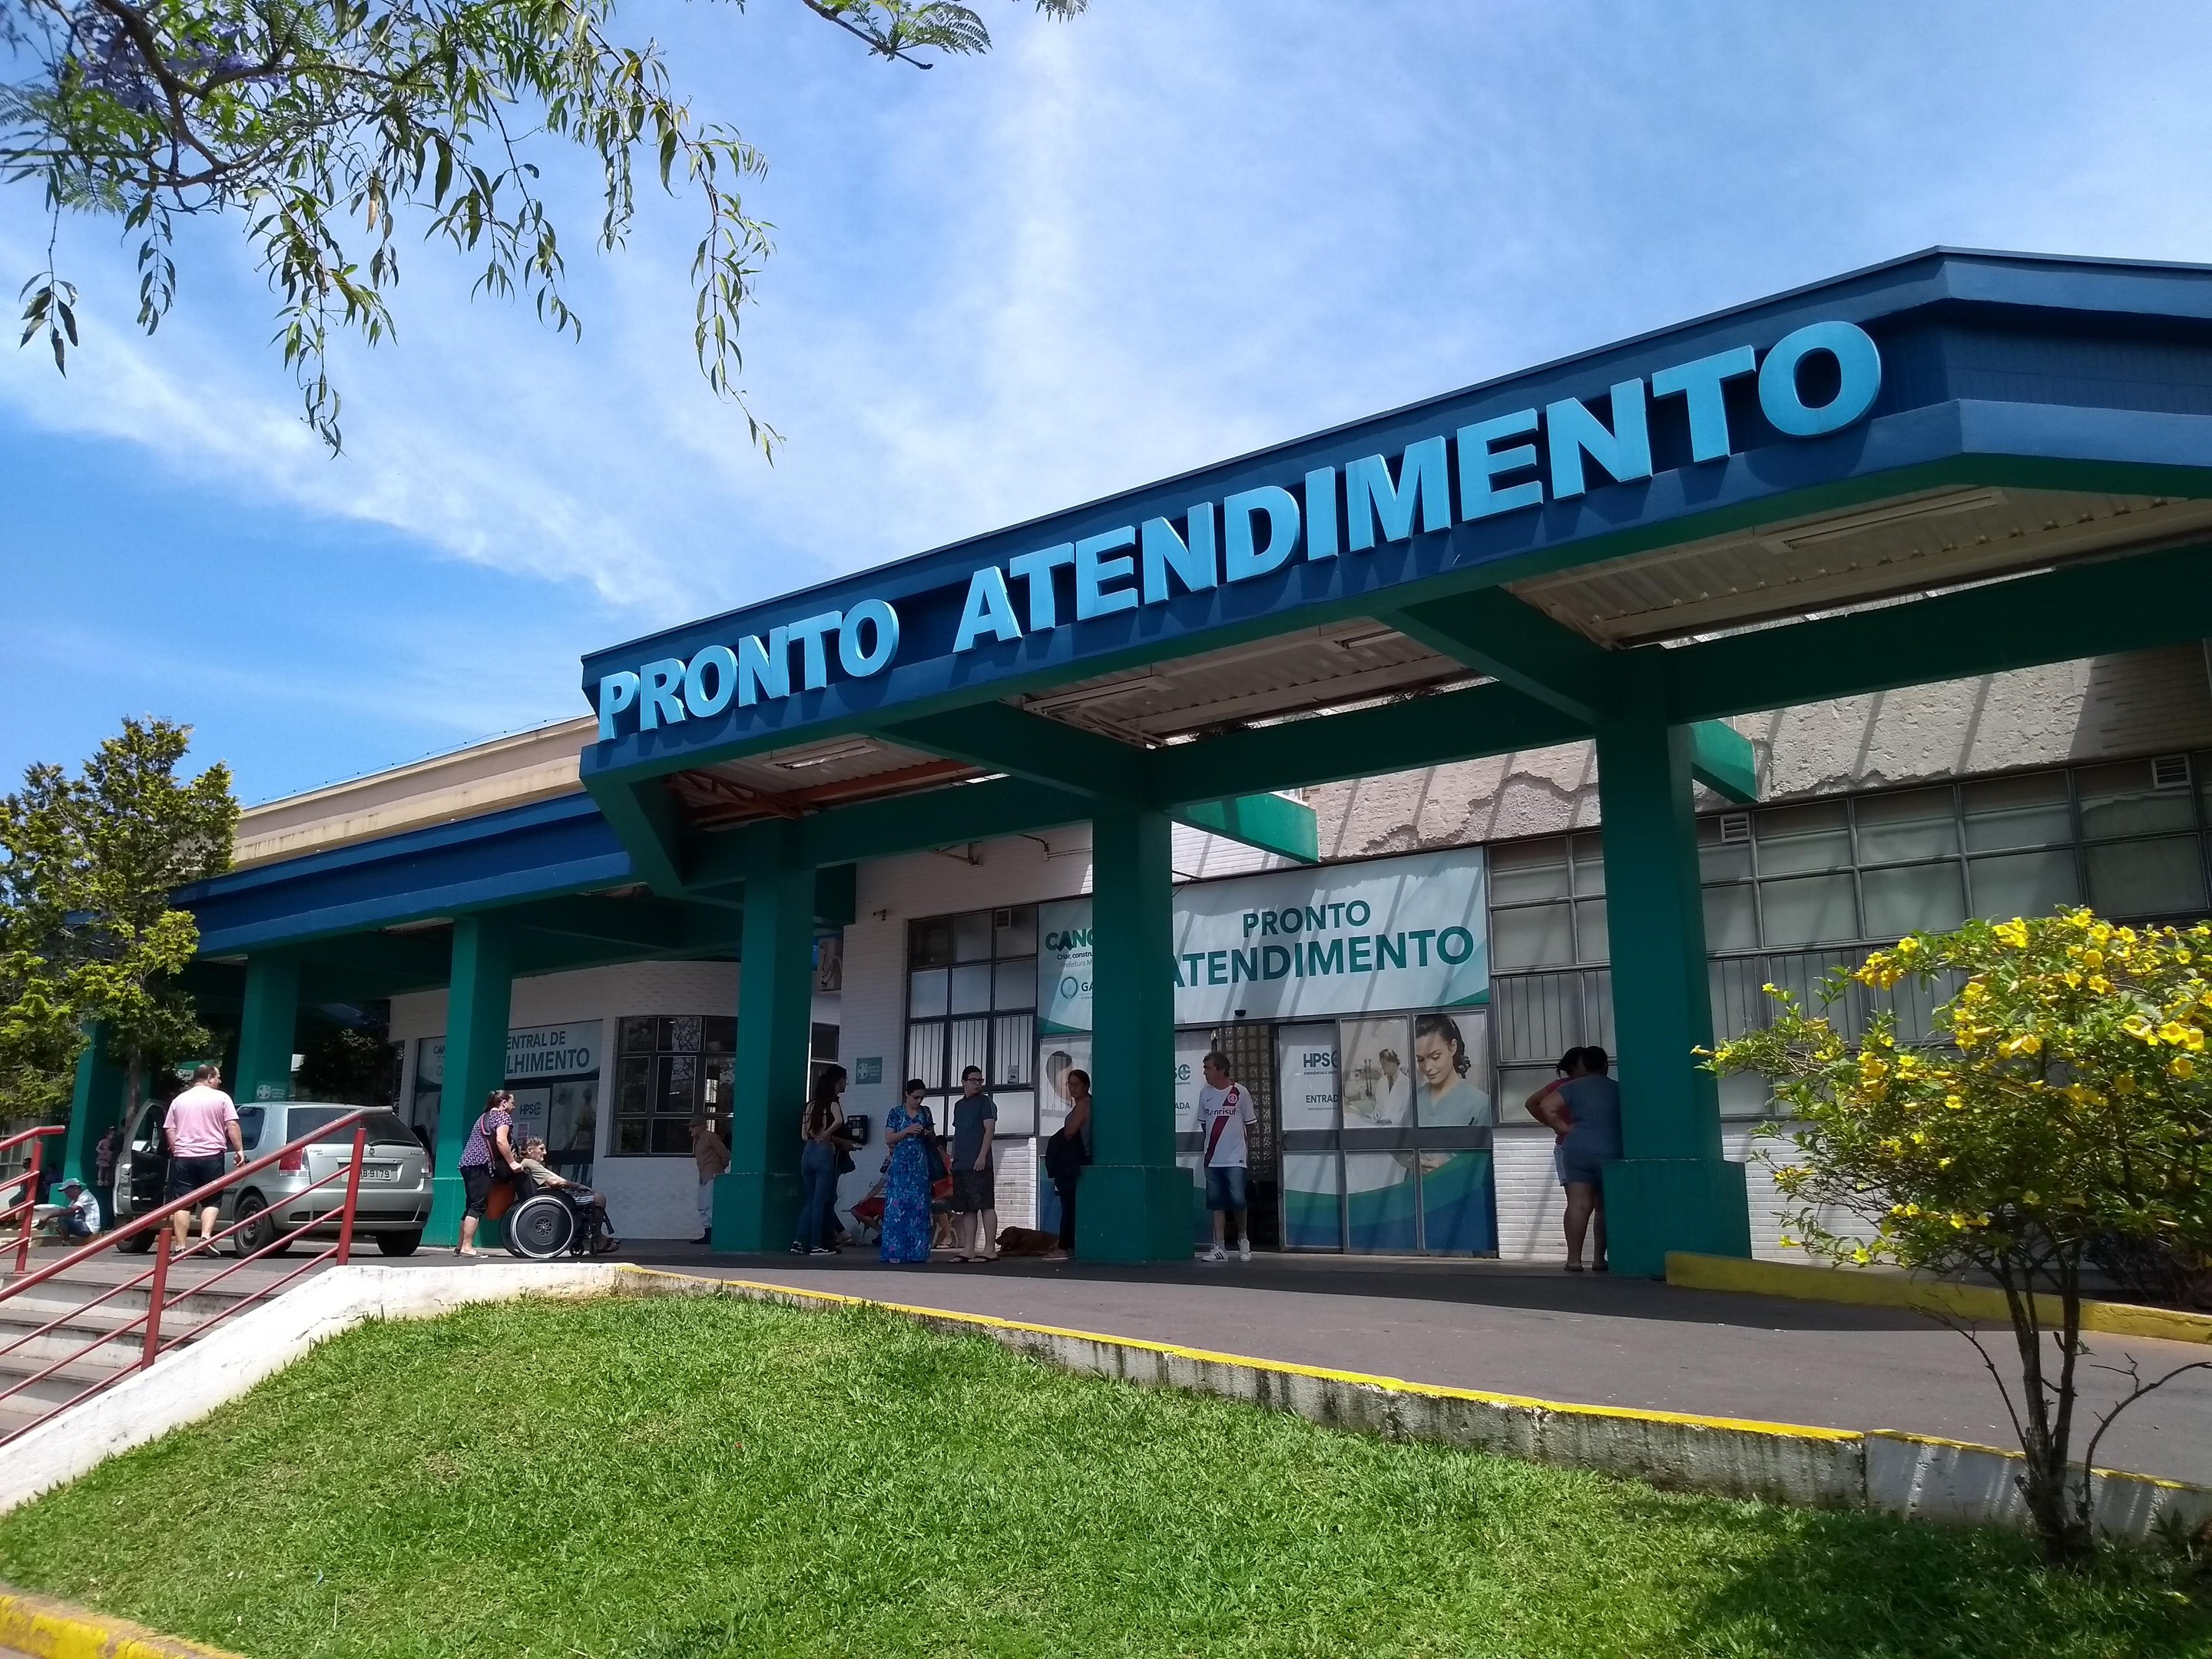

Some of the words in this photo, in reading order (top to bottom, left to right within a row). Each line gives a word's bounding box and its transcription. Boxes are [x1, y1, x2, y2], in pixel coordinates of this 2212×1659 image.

[598, 598, 899, 742] PRONTO
[952, 321, 1881, 654] ATENDIMENTO
[1243, 899, 1371, 938] PRONTO
[550, 1031, 565, 1045] DE
[506, 1048, 590, 1074] LHIMENTO
